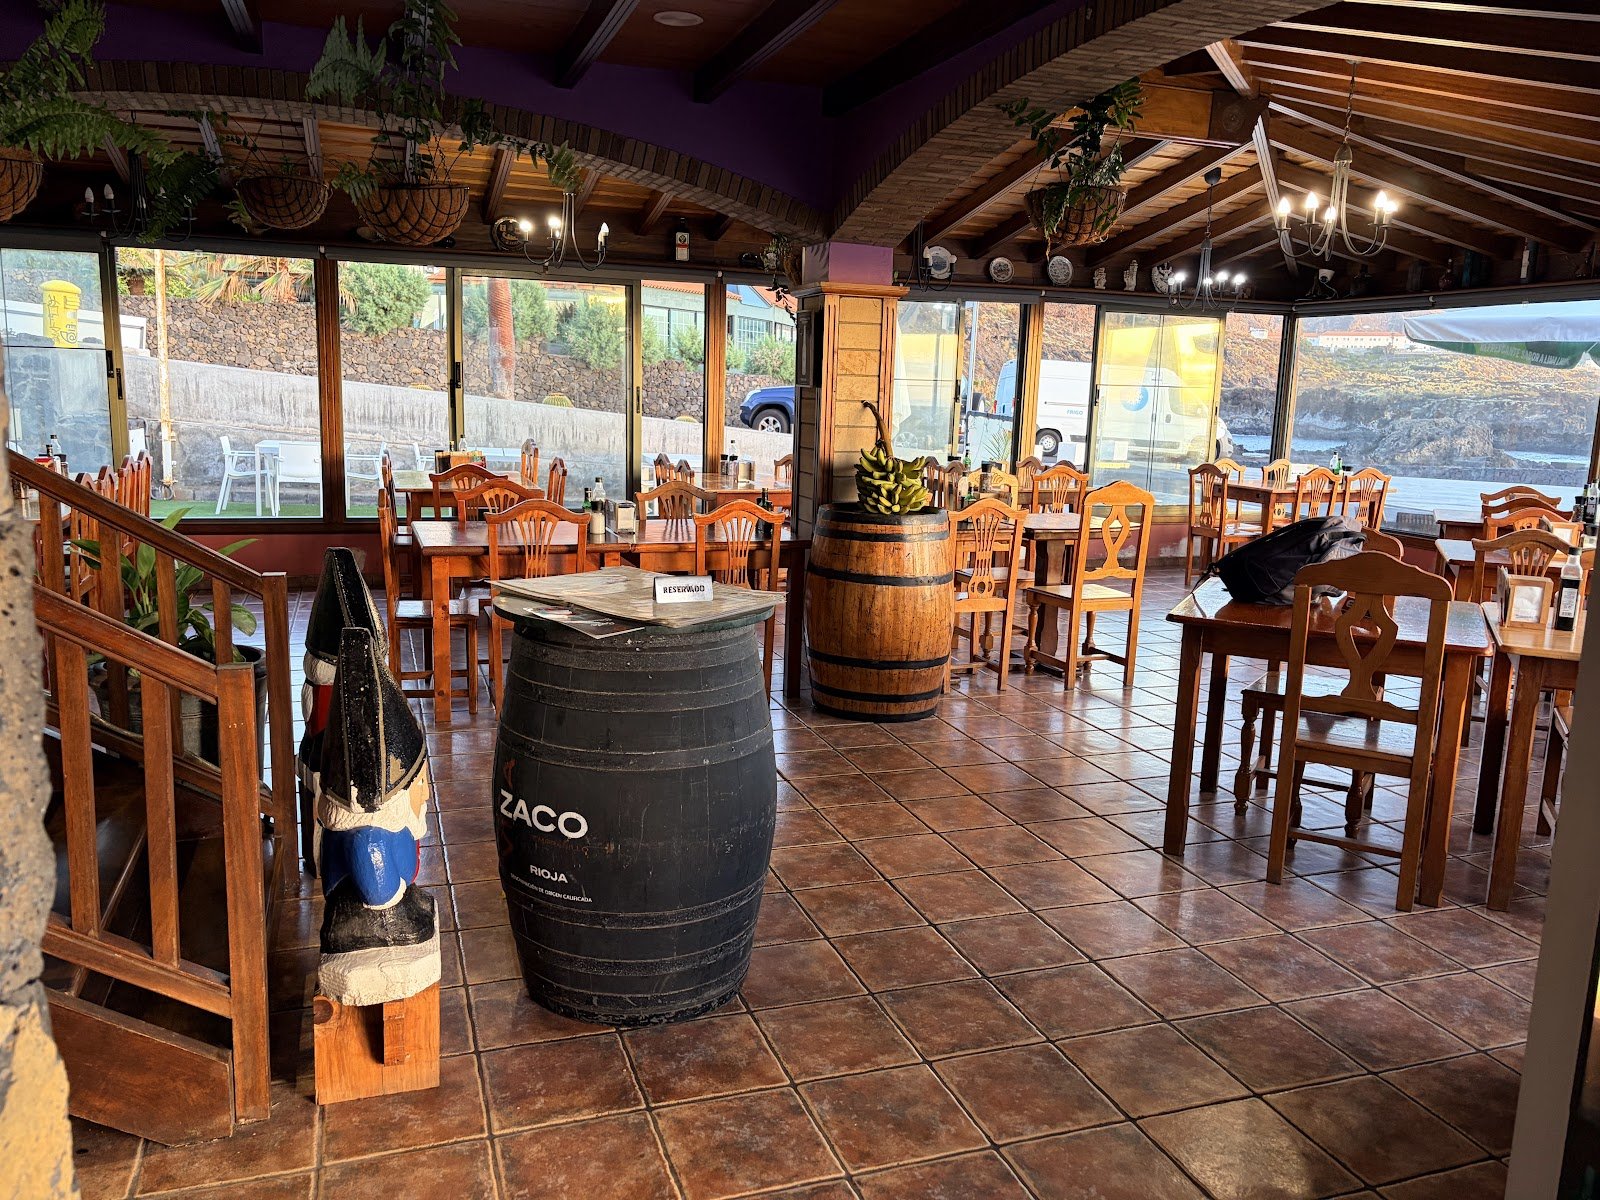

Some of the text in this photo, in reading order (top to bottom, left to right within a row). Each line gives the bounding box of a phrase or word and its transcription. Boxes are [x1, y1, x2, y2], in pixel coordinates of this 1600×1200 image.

[663, 585, 705, 594] RESERVADO
[500, 788, 589, 839] ZACO
[530, 864, 568, 884] RIOJA
[562, 893, 593, 903] CALIFICADA
